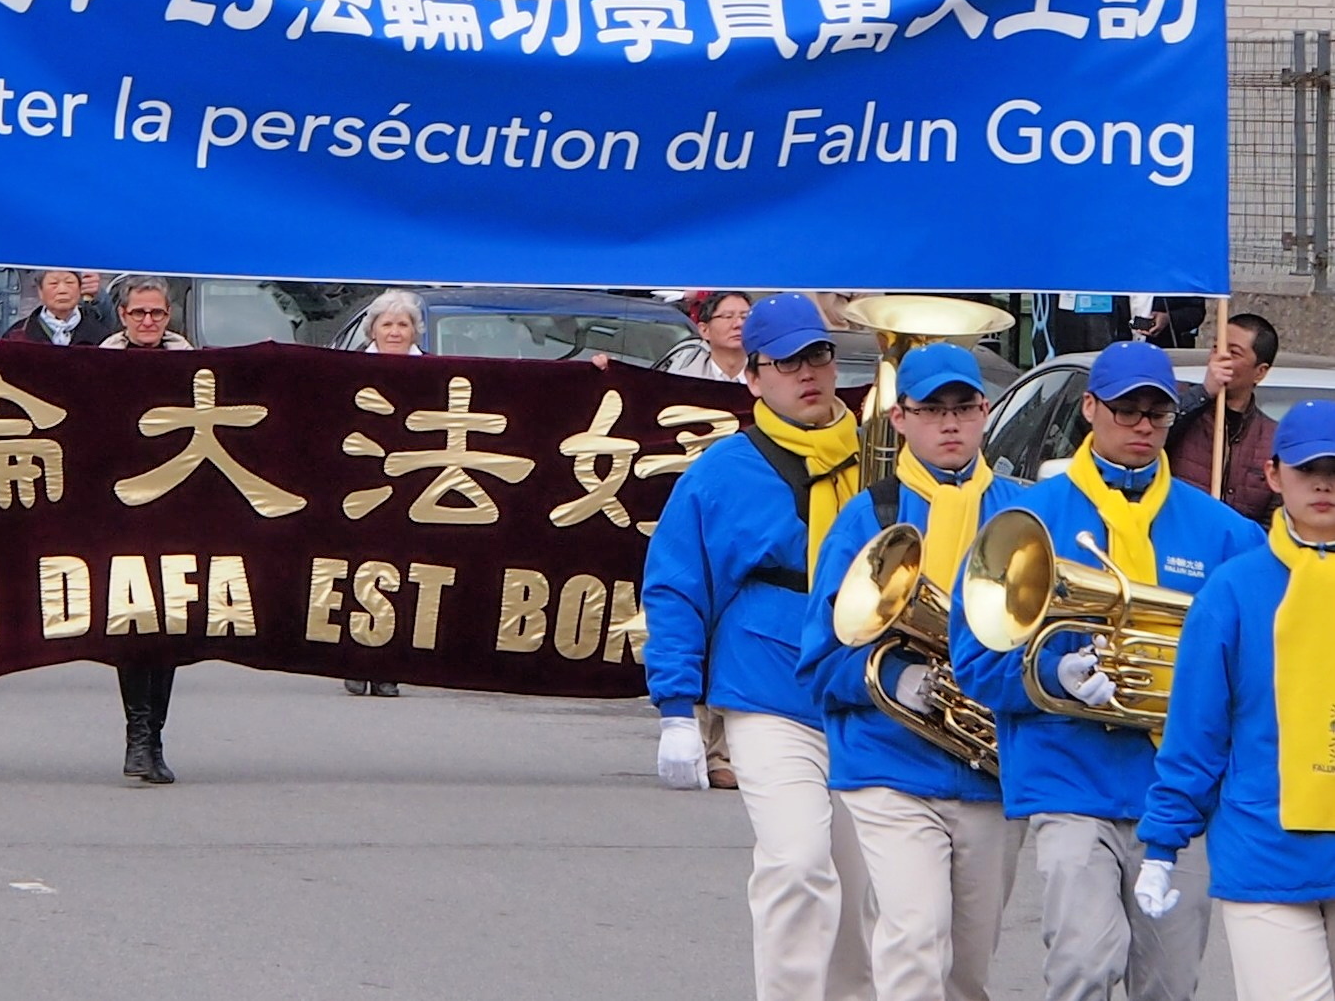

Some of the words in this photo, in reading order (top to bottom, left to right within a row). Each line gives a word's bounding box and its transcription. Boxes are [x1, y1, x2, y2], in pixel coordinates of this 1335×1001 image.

[114, 75, 171, 142] la
[196, 102, 640, 169] persécution
[666, 111, 754, 172] du
[776, 100, 959, 168] Falun
[985, 99, 1195, 187] Gong
[39, 553, 257, 640] DAFA
[305, 556, 456, 650] EST
